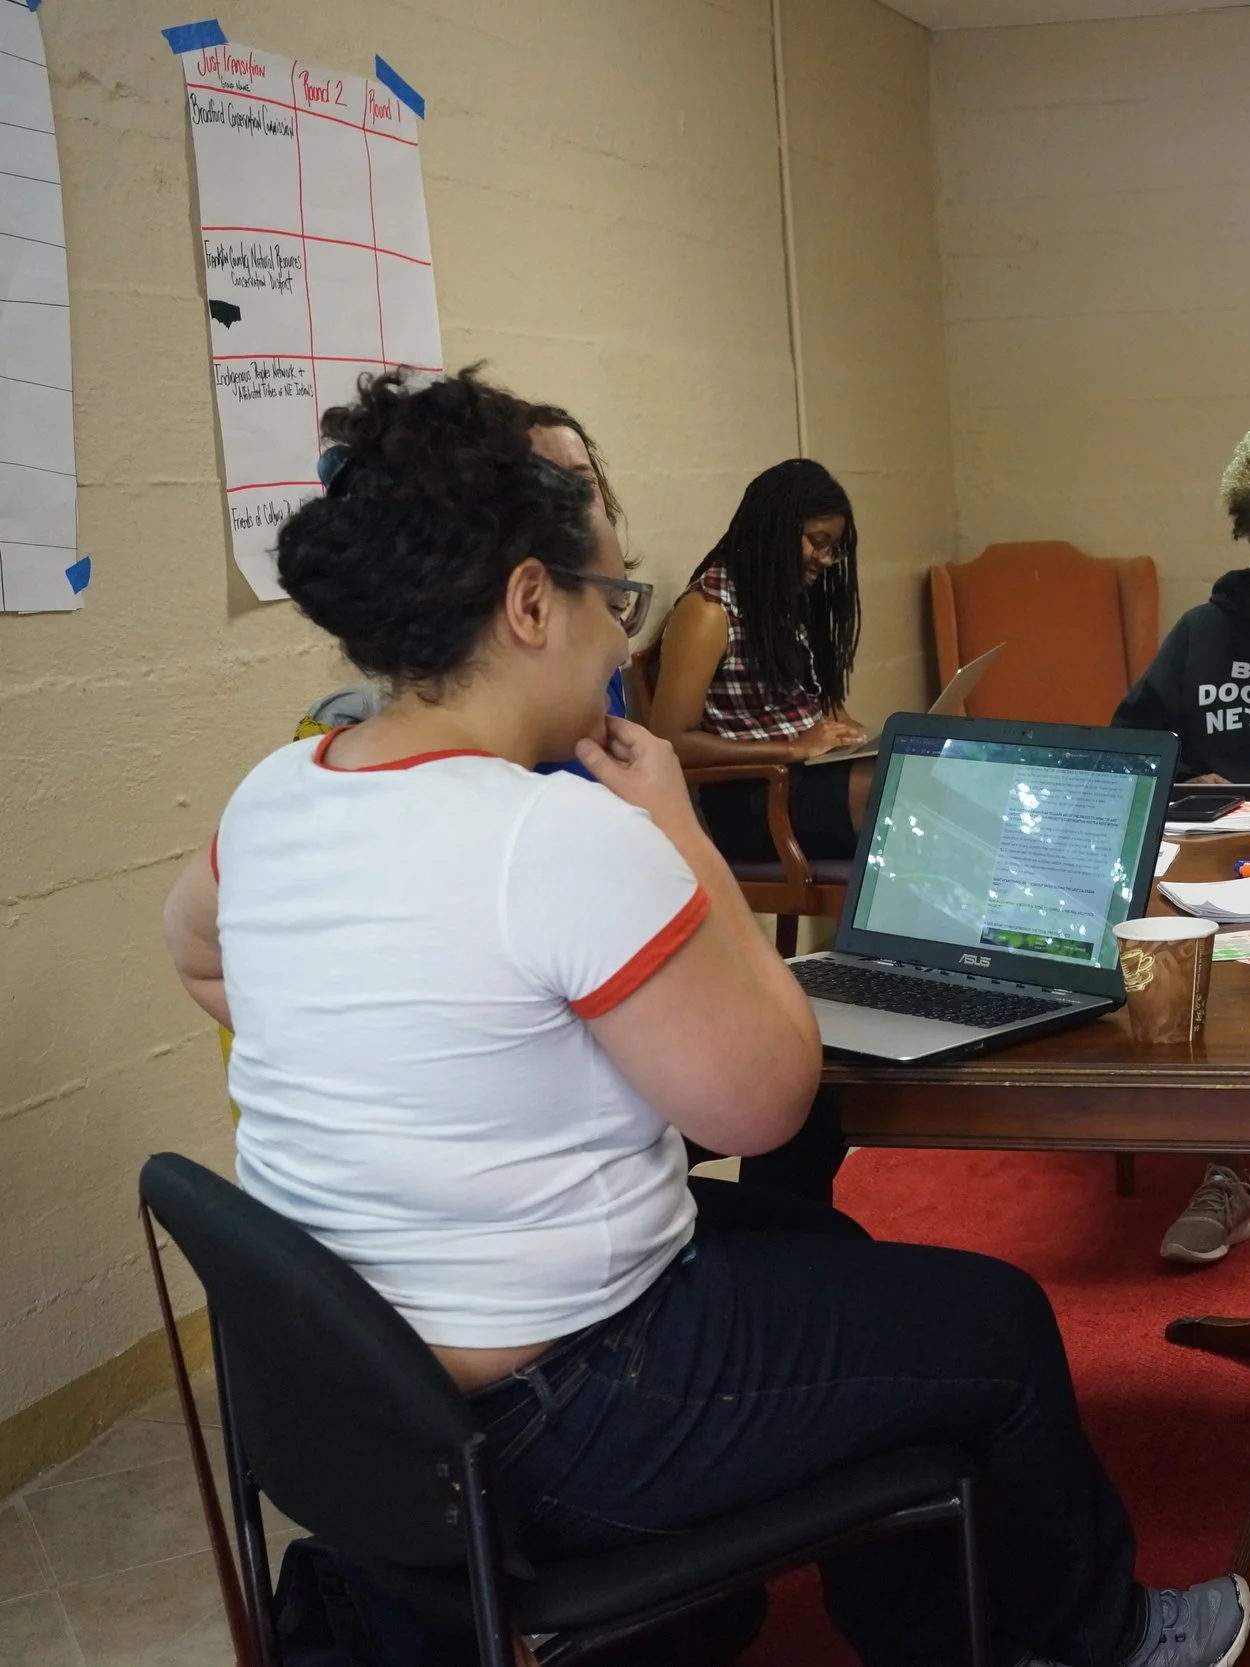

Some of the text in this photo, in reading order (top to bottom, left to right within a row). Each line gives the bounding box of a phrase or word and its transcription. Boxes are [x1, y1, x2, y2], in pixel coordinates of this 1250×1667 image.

[197, 43, 266, 84] Just Transition
[299, 70, 347, 108] Round 2
[190, 92, 225, 125] Bradford
[368, 90, 392, 124] Round
[229, 241, 251, 276] County
[250, 243, 275, 271] Natural
[213, 364, 252, 396] Indigenous
[231, 507, 254, 531] Friends
[255, 505, 262, 527] of
[958, 952, 992, 968] ASUS
